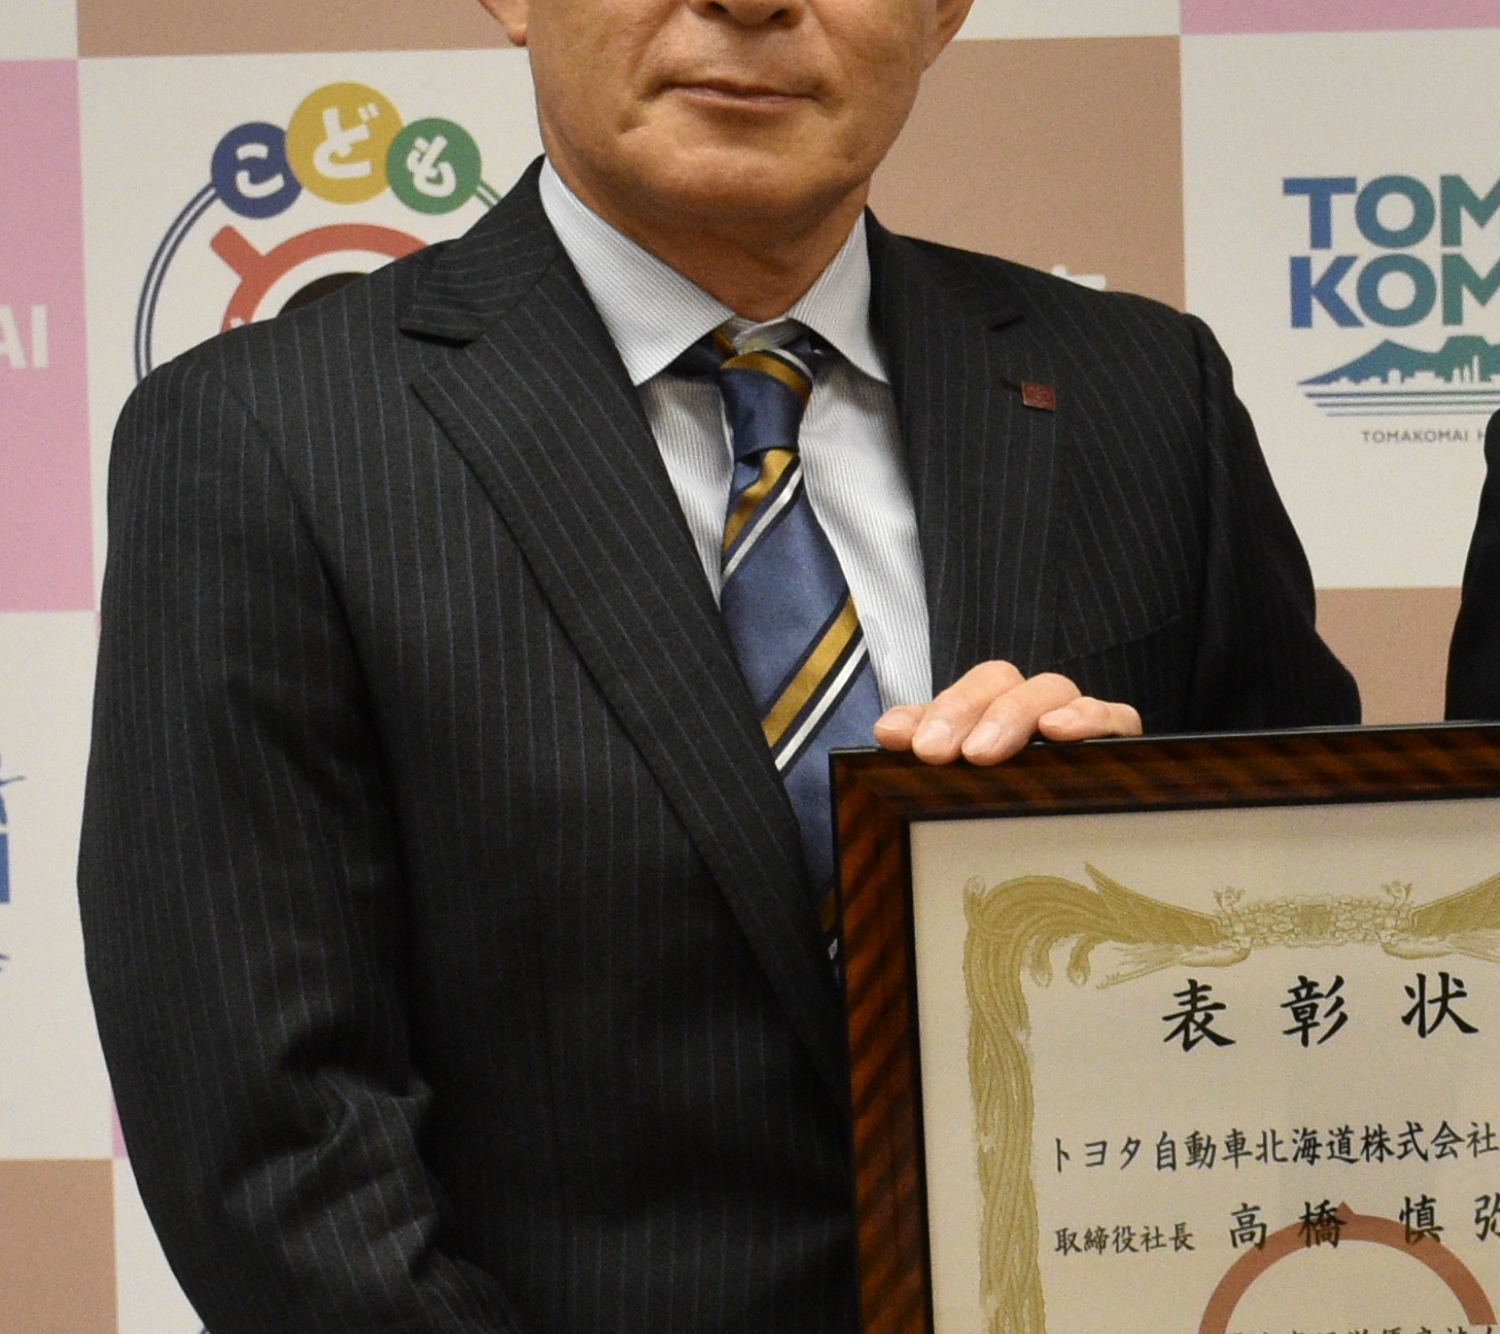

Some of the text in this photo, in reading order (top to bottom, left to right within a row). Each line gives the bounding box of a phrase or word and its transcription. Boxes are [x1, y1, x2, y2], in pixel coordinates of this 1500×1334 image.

[234, 102, 457, 197] こども
[1361, 428, 1470, 446] TOMAKOMAI
[1161, 971, 1480, 1053] 表彰状
[1055, 1120, 1500, 1172] トヨタ自動車北海道株式会社
[1054, 1221, 1197, 1256] 取締役社長
